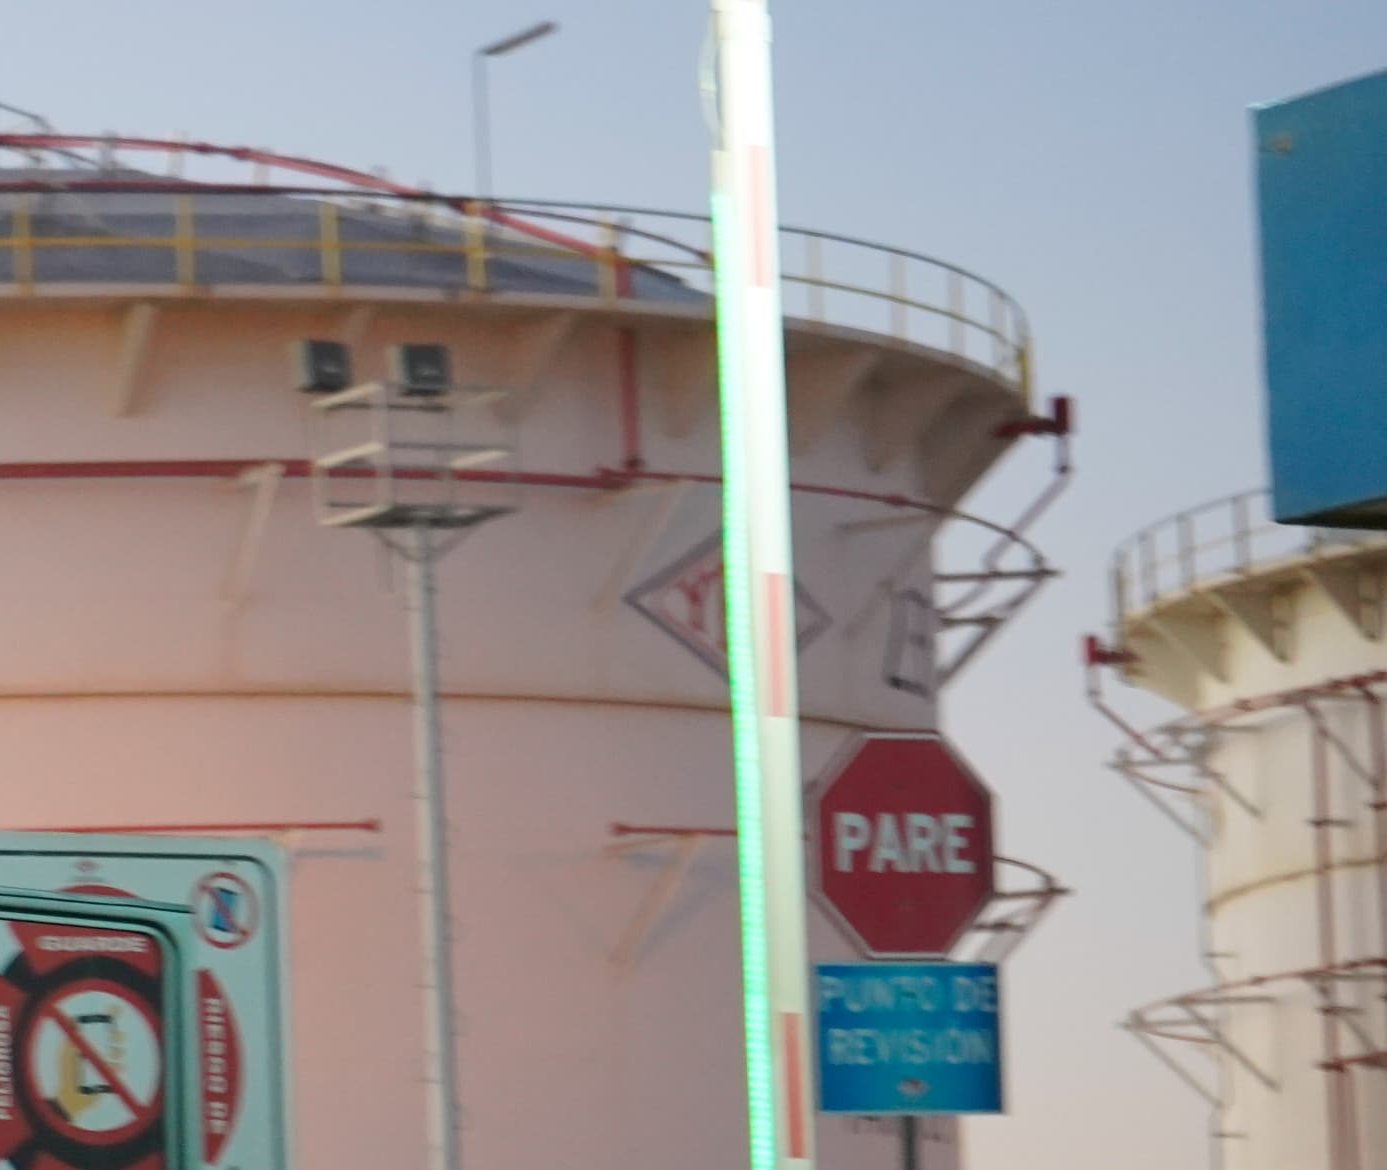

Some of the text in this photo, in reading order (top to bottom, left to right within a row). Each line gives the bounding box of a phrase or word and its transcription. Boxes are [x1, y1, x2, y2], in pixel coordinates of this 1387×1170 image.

[832, 812, 977, 874] PARE
[821, 975, 996, 1013] PUNTO DE
